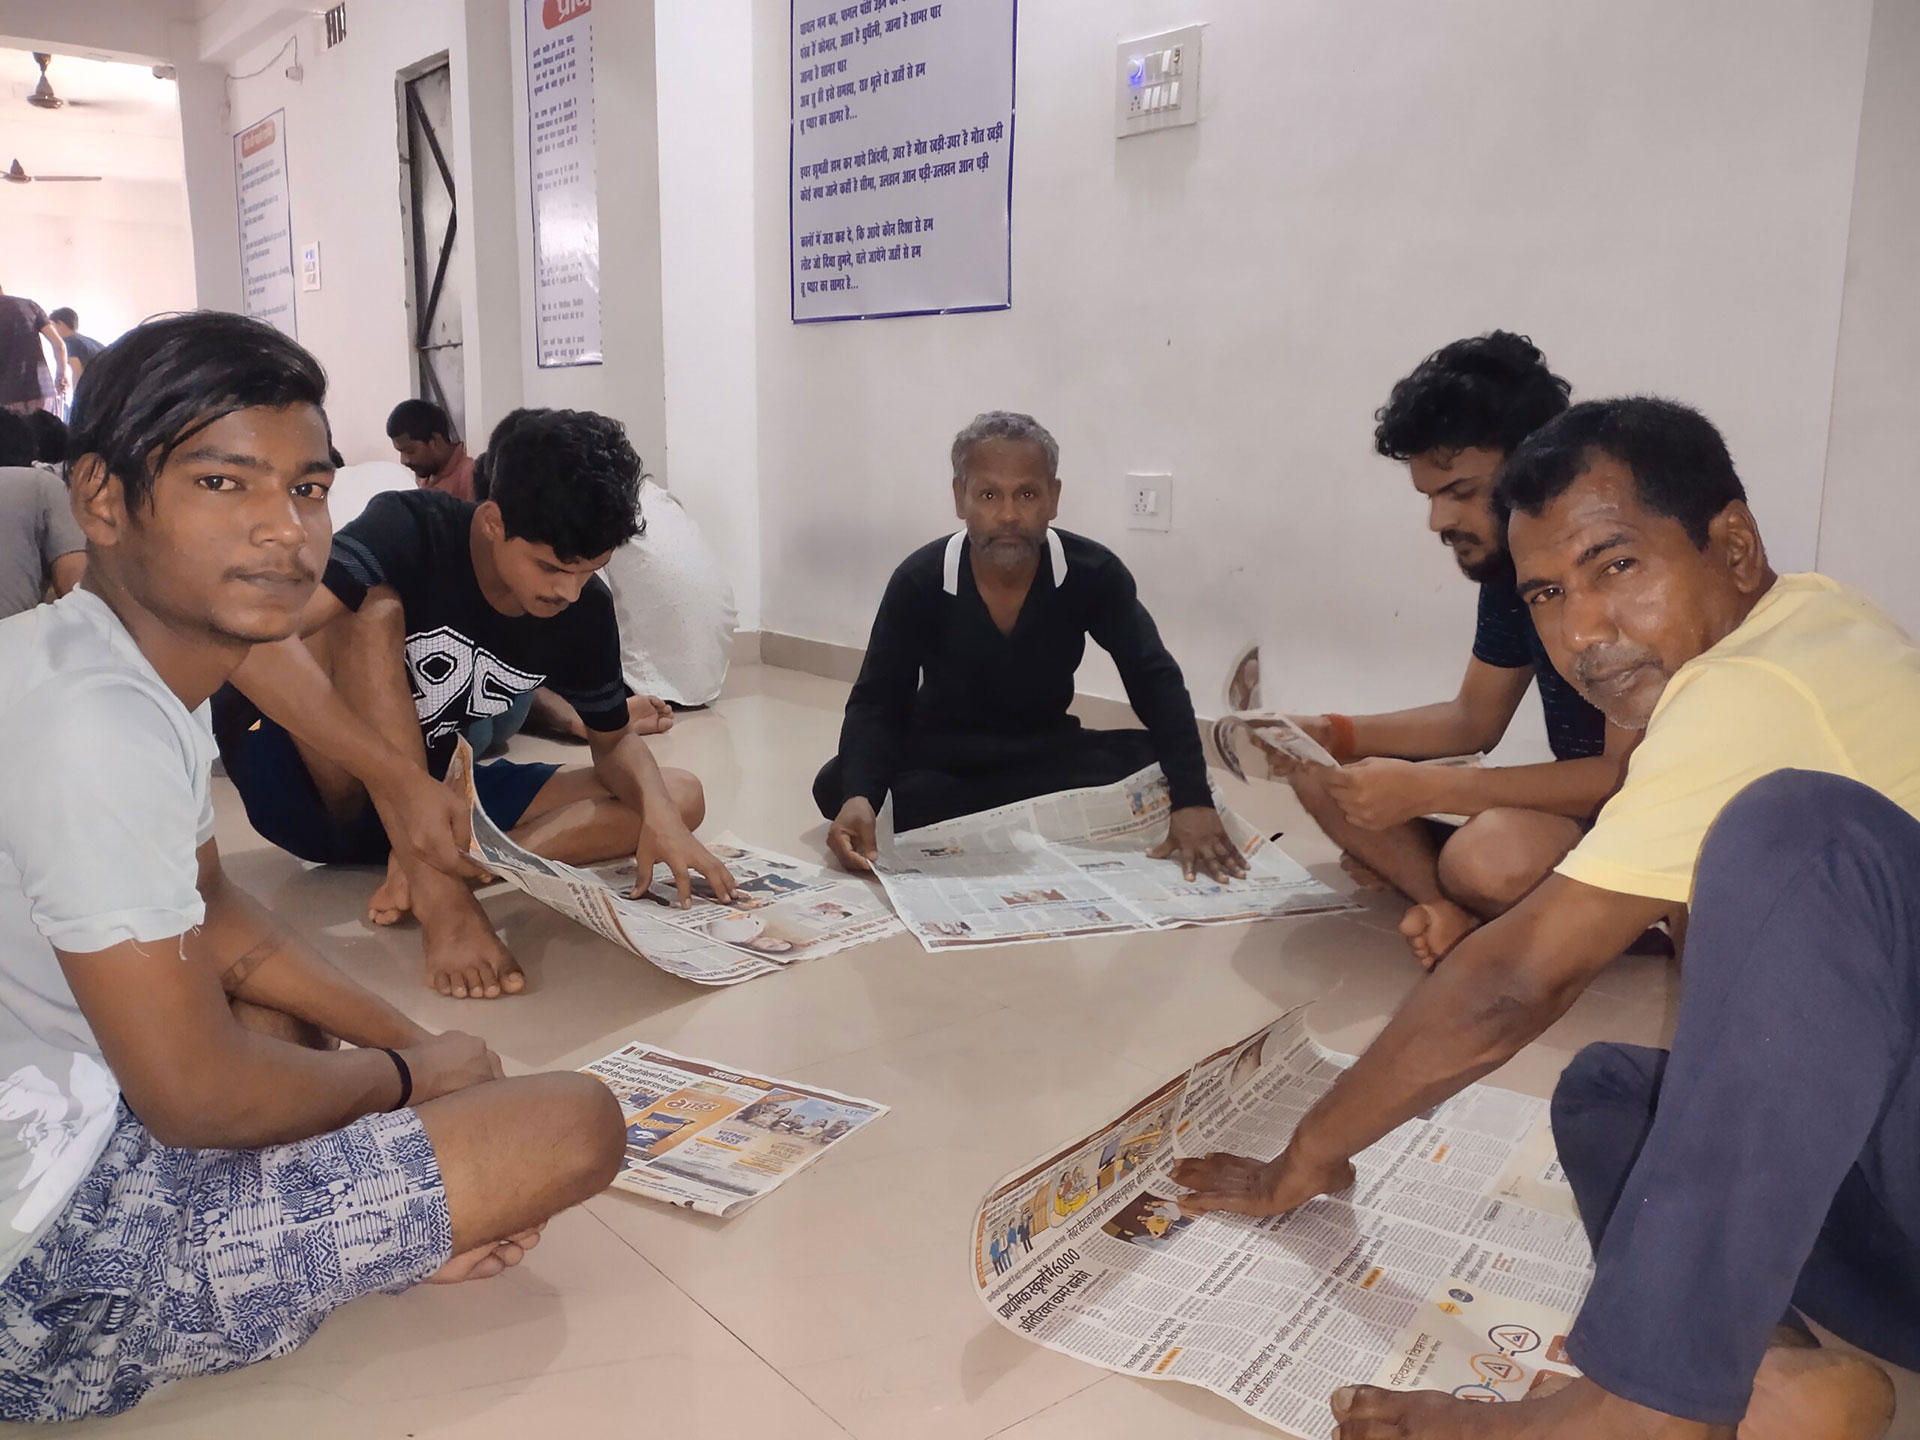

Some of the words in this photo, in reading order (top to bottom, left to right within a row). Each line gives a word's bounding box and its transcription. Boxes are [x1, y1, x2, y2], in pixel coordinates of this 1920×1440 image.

[841, 6, 857, 21] पागल
[856, 27, 859, 42] है
[885, 17, 901, 32] जाना
[903, 12, 908, 27] है
[911, 9, 927, 25] सागर
[930, 4, 941, 19] पार
[815, 65, 819, 79] है
[821, 62, 835, 78] सागर
[838, 59, 847, 72] पार
[801, 94, 809, 108] अब
[812, 93, 816, 109] तू
[818, 88, 823, 103] ही
[826, 84, 834, 101] इसे
[907, 63, 913, 79] से
[915, 62, 926, 76] हम
[800, 120, 805, 135] तू
[807, 116, 817, 129] प्यार
[819, 113, 826, 126] का
[829, 110, 843, 123] सागर
[801, 166, 811, 180] इधर
[844, 155, 852, 170] कर
[893, 146, 904, 159] उधर
[907, 142, 911, 157] है
[963, 129, 968, 146] है
[987, 121, 1003, 140] खड़ी
[801, 187, 811, 202] कोई
[813, 185, 823, 198] क्या
[825, 180, 837, 197] जाने
[854, 177, 858, 192] है
[879, 172, 900, 187] उलझन
[903, 170, 916, 183] आन
[959, 159, 973, 173] आन
[977, 152, 989, 173] पड़ी
[801, 231, 814, 248] कानों
[835, 230, 845, 243] कह
[856, 226, 864, 240] कि
[867, 223, 880, 239] आये
[915, 216, 921, 232] से
[924, 217, 933, 231] हम
[813, 256, 820, 269] जो
[856, 249, 866, 264] चले
[903, 244, 909, 258] से
[911, 245, 921, 257] हम
[801, 282, 805, 298] तू
[807, 280, 818, 293] प्यार
[820, 280, 827, 292] का
[830, 278, 844, 291] सागर
[998, 1288, 1032, 1319] प्राथमिक
[1025, 1269, 1052, 1295] स्कूलों
[1052, 1248, 1080, 1274] 6000
[1020, 1298, 1057, 1332] अतिरिक्त
[1051, 1284, 1074, 1304] कमरे
[1068, 1270, 1092, 1289] बनेंगे
[1390, 1357, 1414, 1385] परिवहन
